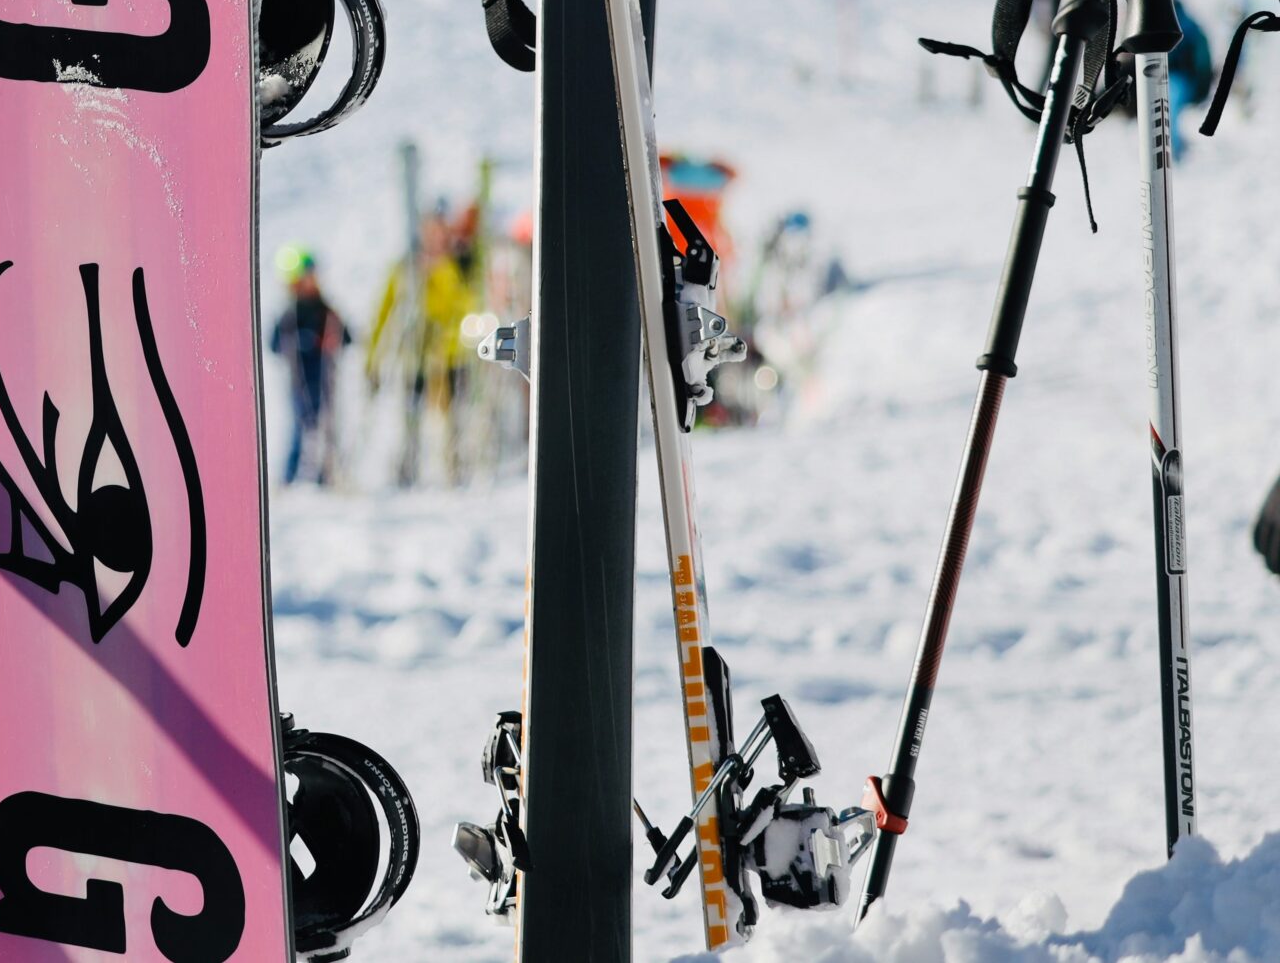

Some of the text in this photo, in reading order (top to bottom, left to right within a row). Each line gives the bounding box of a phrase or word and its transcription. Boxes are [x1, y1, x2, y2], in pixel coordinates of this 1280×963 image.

[1176, 656, 1195, 818] ITALBASTONI
[363, 759, 398, 798] UNION
[394, 799, 409, 863] BINDING
